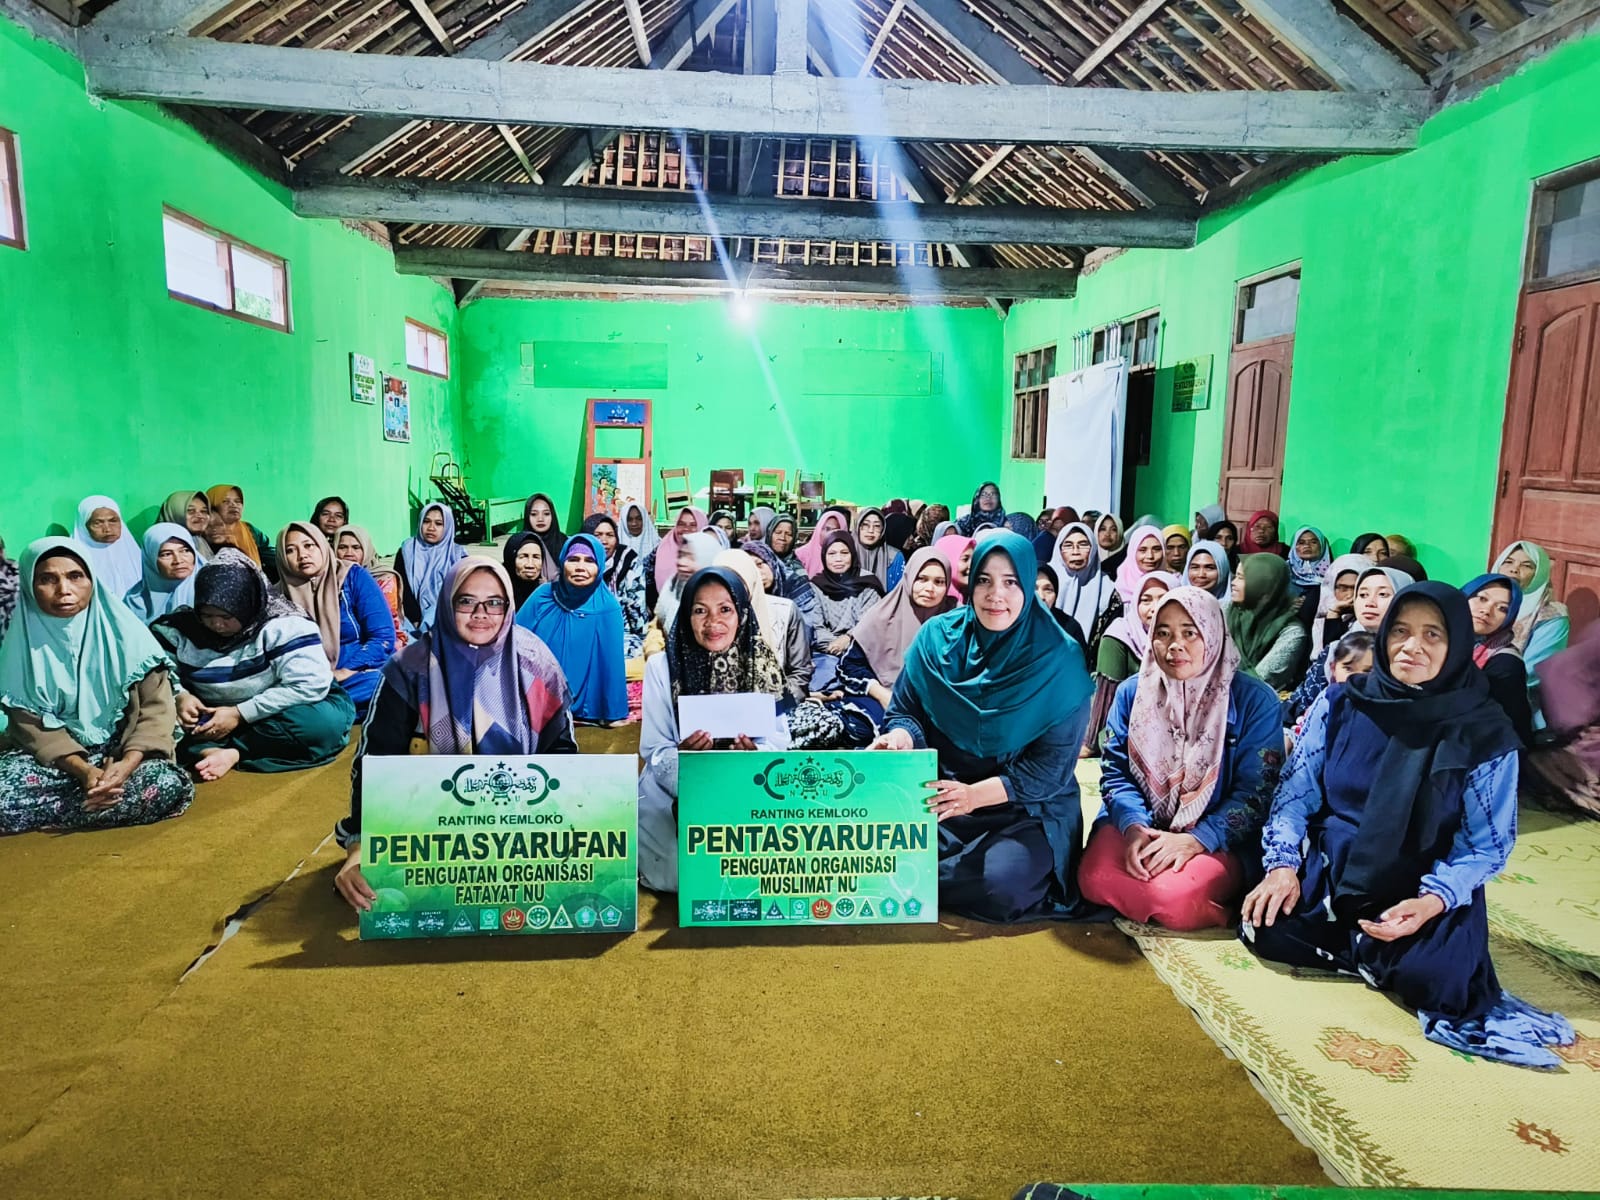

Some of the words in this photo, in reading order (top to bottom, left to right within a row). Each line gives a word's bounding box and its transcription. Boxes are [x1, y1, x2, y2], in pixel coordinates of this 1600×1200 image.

[438, 815, 496, 826] RANTING
[500, 814, 563, 825] KEMLOKO
[751, 808, 805, 819] RANTING
[808, 807, 868, 818] KEMLOKO
[369, 831, 627, 864] PENTASYARUFAN
[688, 824, 928, 853] PENTASYARUFAN
[405, 865, 498, 886] PENGUATAN
[503, 864, 593, 883] ORGANISASI
[721, 857, 806, 876] PENGUATAN
[811, 856, 896, 874] ORGANISASI
[455, 885, 519, 905] FATAYAT
[523, 884, 545, 902] NU
[760, 876, 833, 895] MUSLIMAT
[838, 876, 858, 893] NU
